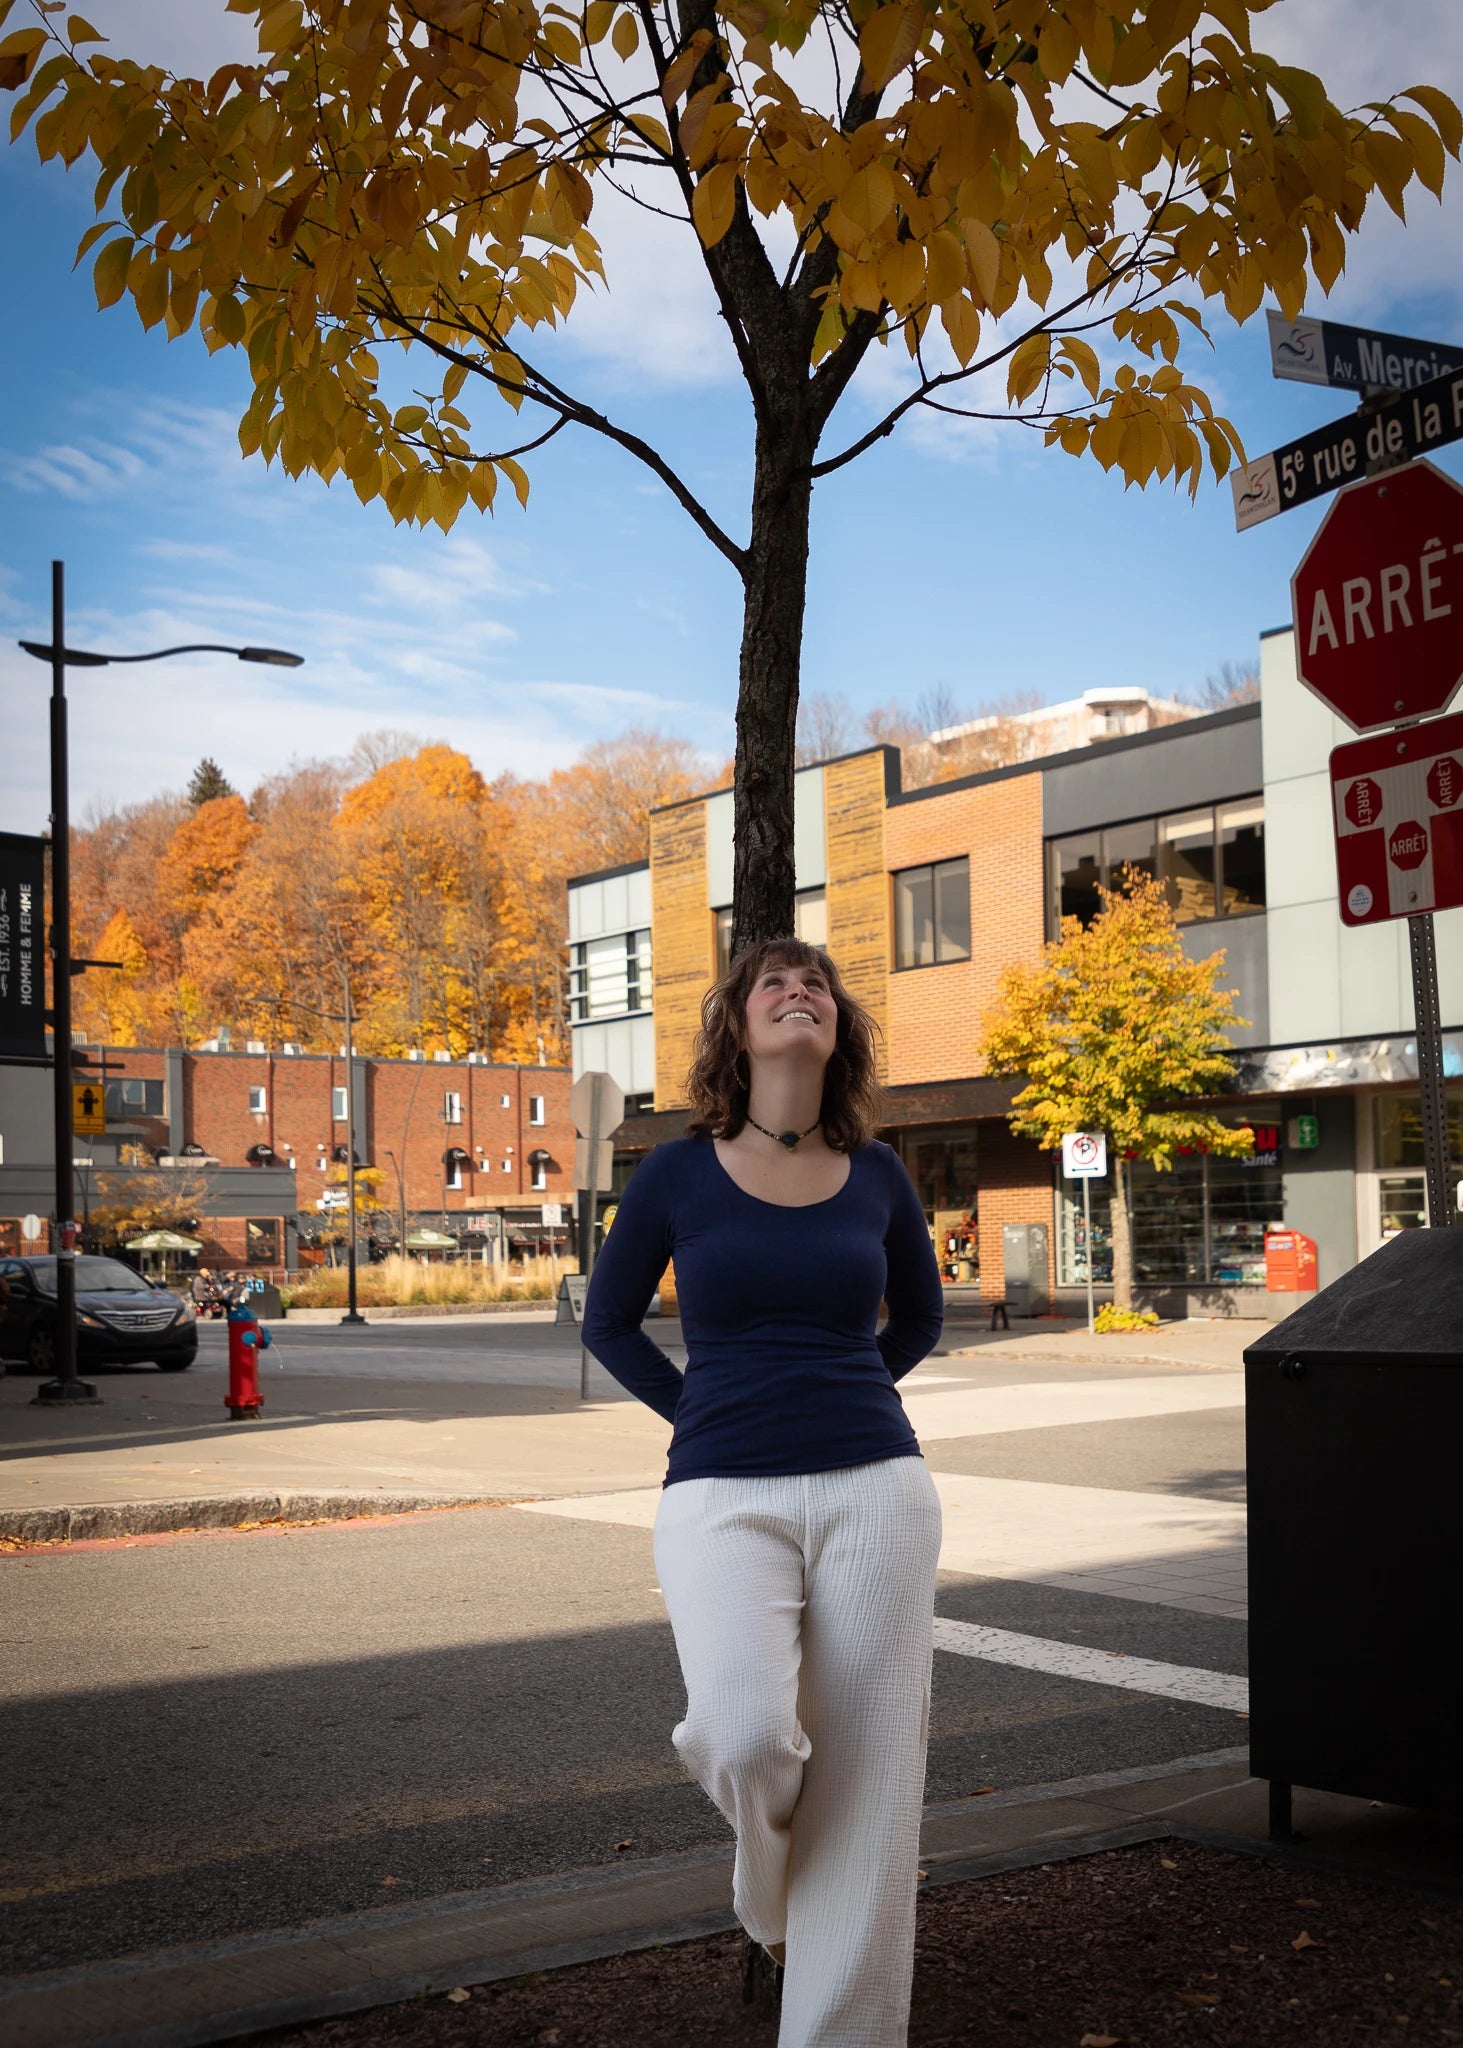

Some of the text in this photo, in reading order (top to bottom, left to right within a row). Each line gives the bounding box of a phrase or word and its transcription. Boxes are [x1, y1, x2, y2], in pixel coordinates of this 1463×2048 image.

[1333, 355, 1357, 379] Av.
[1281, 449, 1304, 499] 5e
[1313, 437, 1357, 486] rue
[1366, 414, 1404, 461] de
[1413, 398, 1442, 444] la
[1355, 782, 1373, 824] ARRÊT
[1436, 760, 1453, 805] ARRÊT
[1391, 833, 1426, 857] ARRÊT
[0, 914, 10, 972] EST. 1936
[19, 883, 32, 1005] HOMME & FEMME
